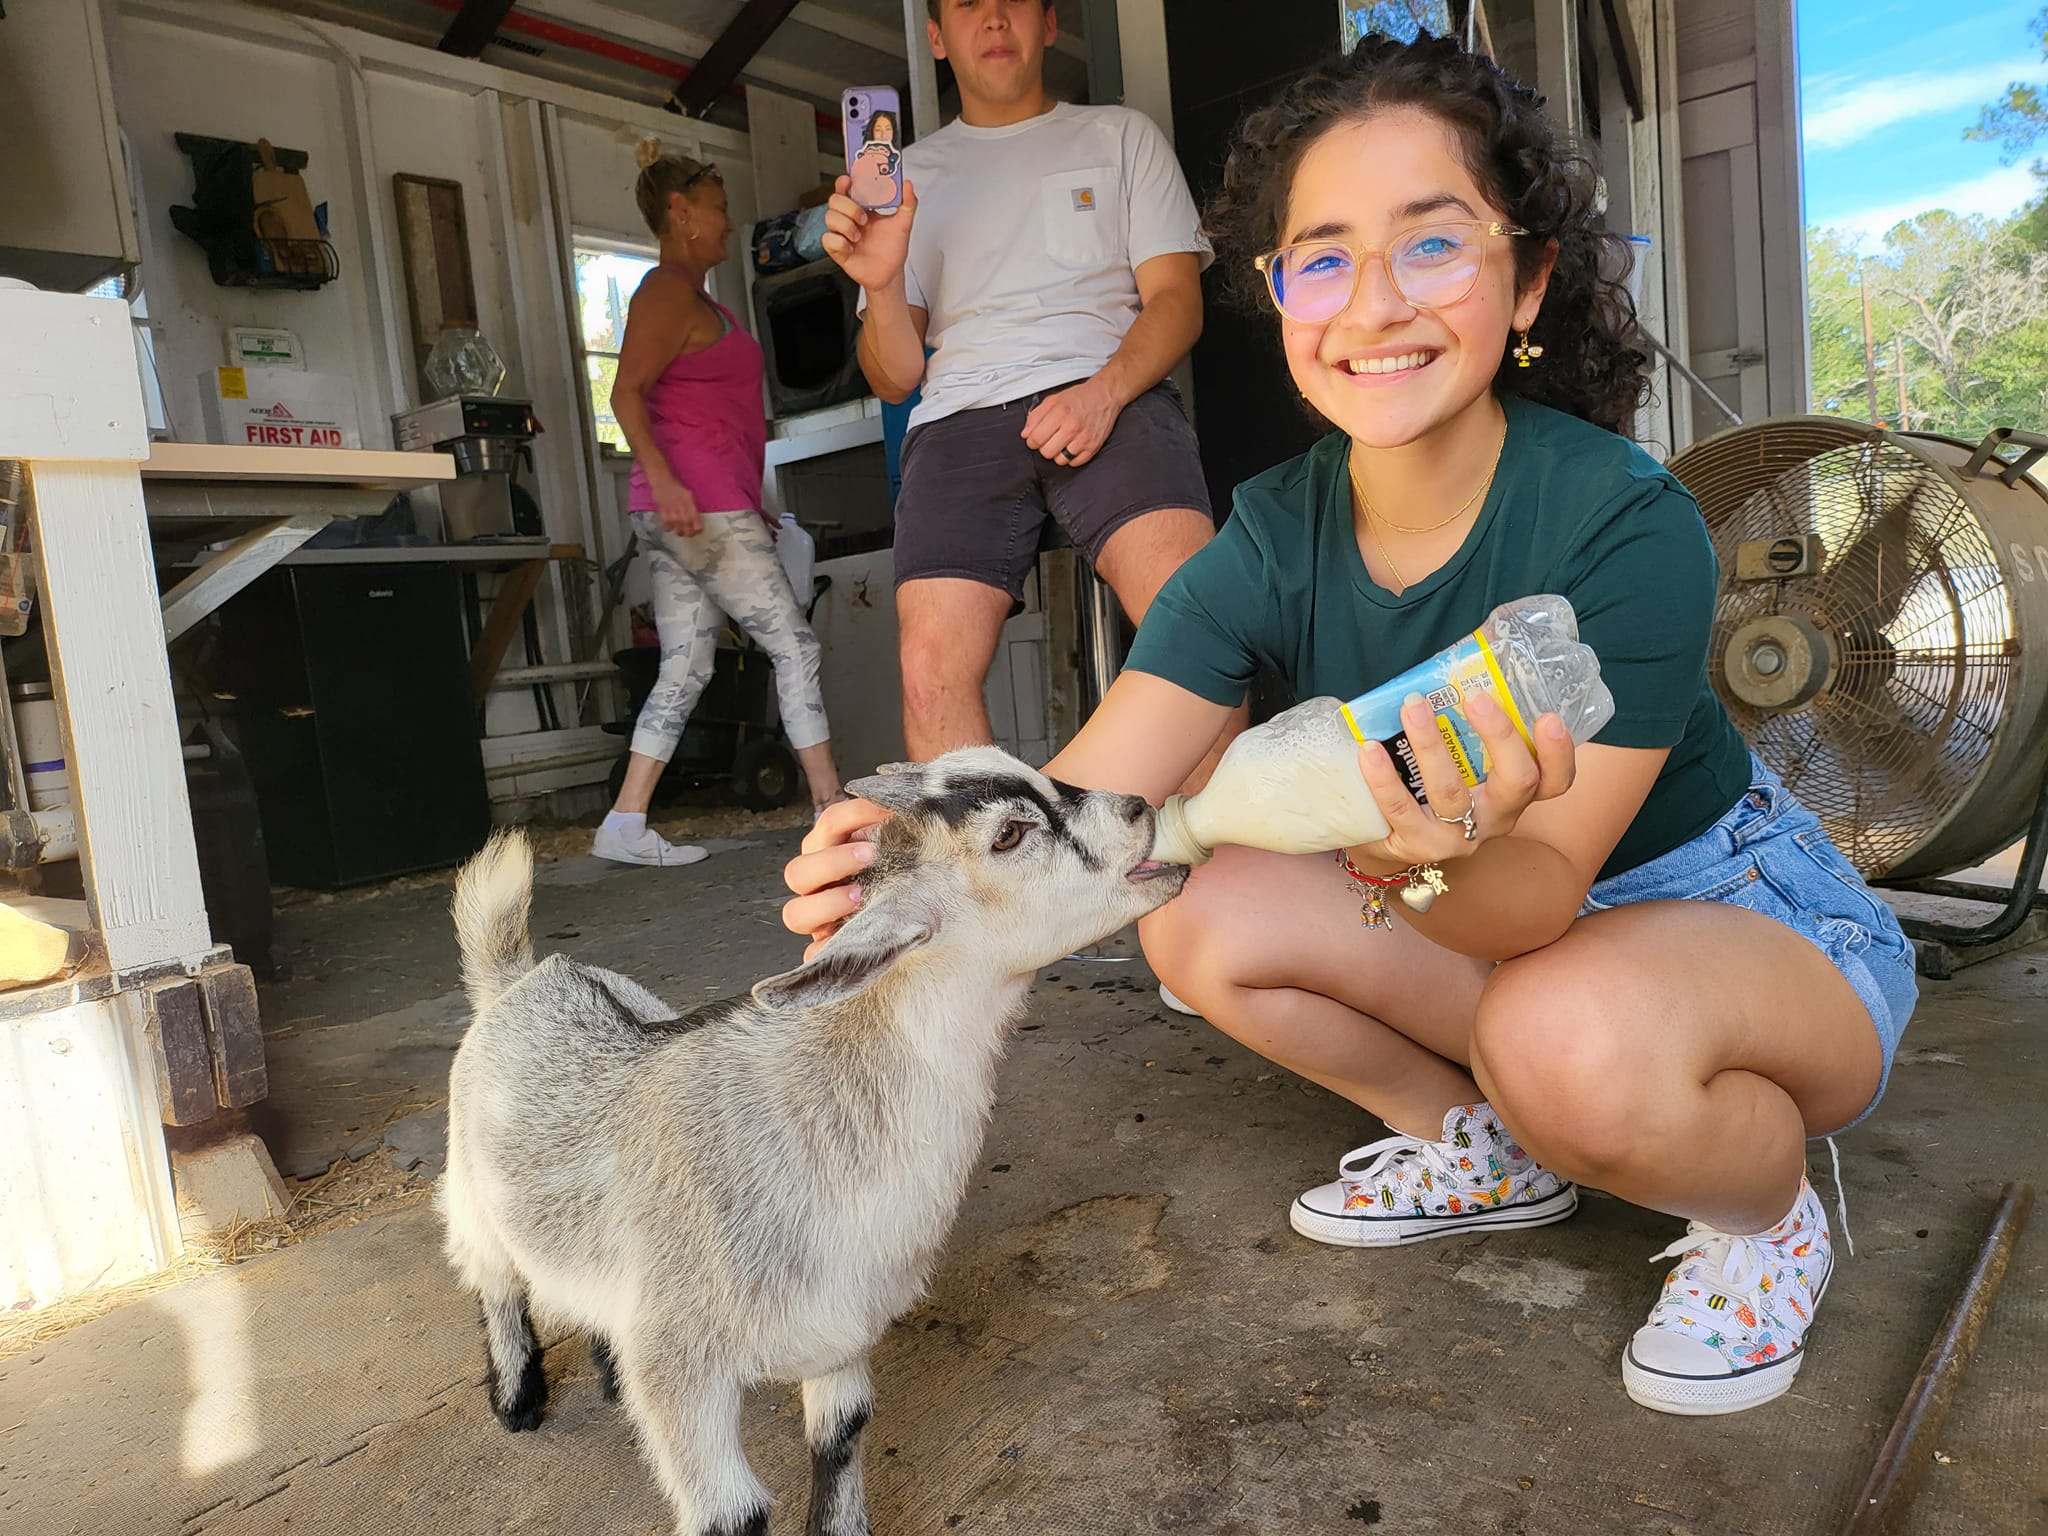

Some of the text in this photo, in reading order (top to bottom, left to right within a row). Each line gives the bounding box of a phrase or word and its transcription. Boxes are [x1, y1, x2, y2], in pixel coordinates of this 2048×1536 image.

[246, 425, 342, 447] FIRST AID
[1429, 692, 1446, 709] 260
[1395, 738, 1426, 800] Minute
[1440, 727, 1470, 779] LEMONADE
